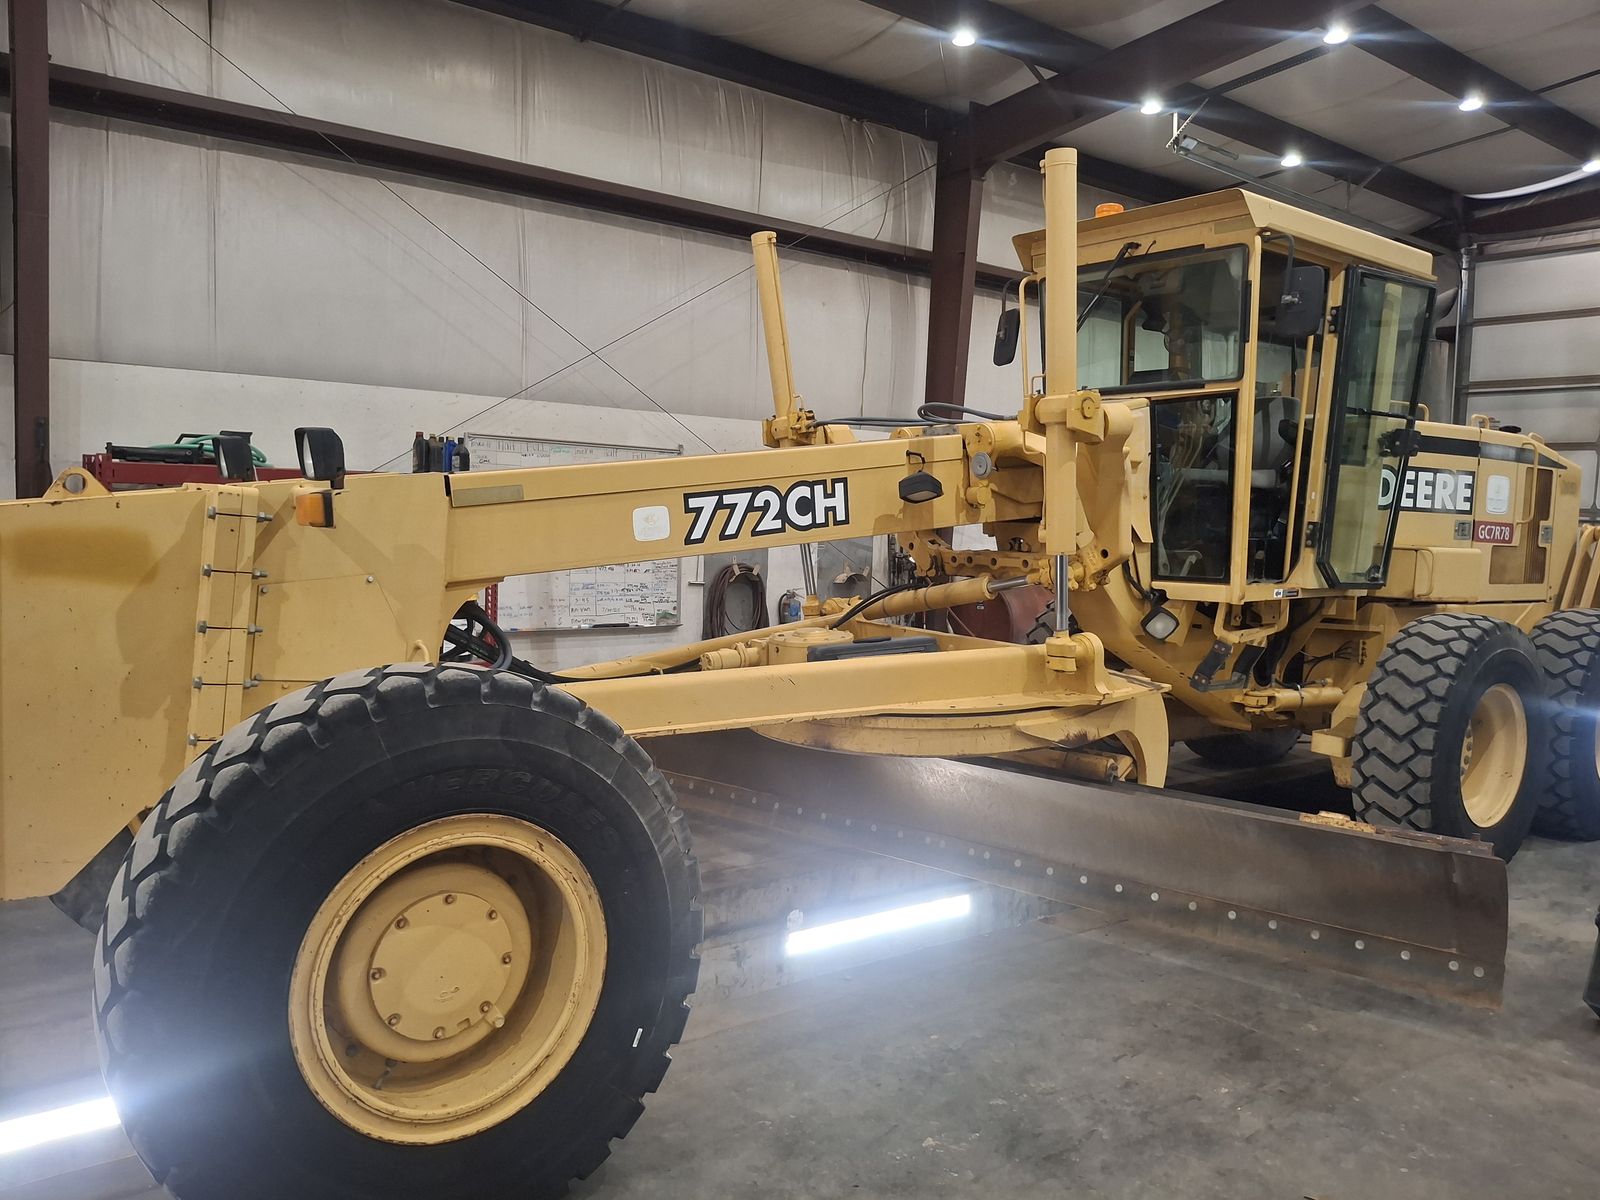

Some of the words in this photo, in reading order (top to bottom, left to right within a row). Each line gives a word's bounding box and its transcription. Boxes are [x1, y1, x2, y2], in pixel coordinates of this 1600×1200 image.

[684, 477, 848, 544] 772CH
[1377, 467, 1474, 513] DEERE
[1477, 524, 1511, 541] GC7R78
